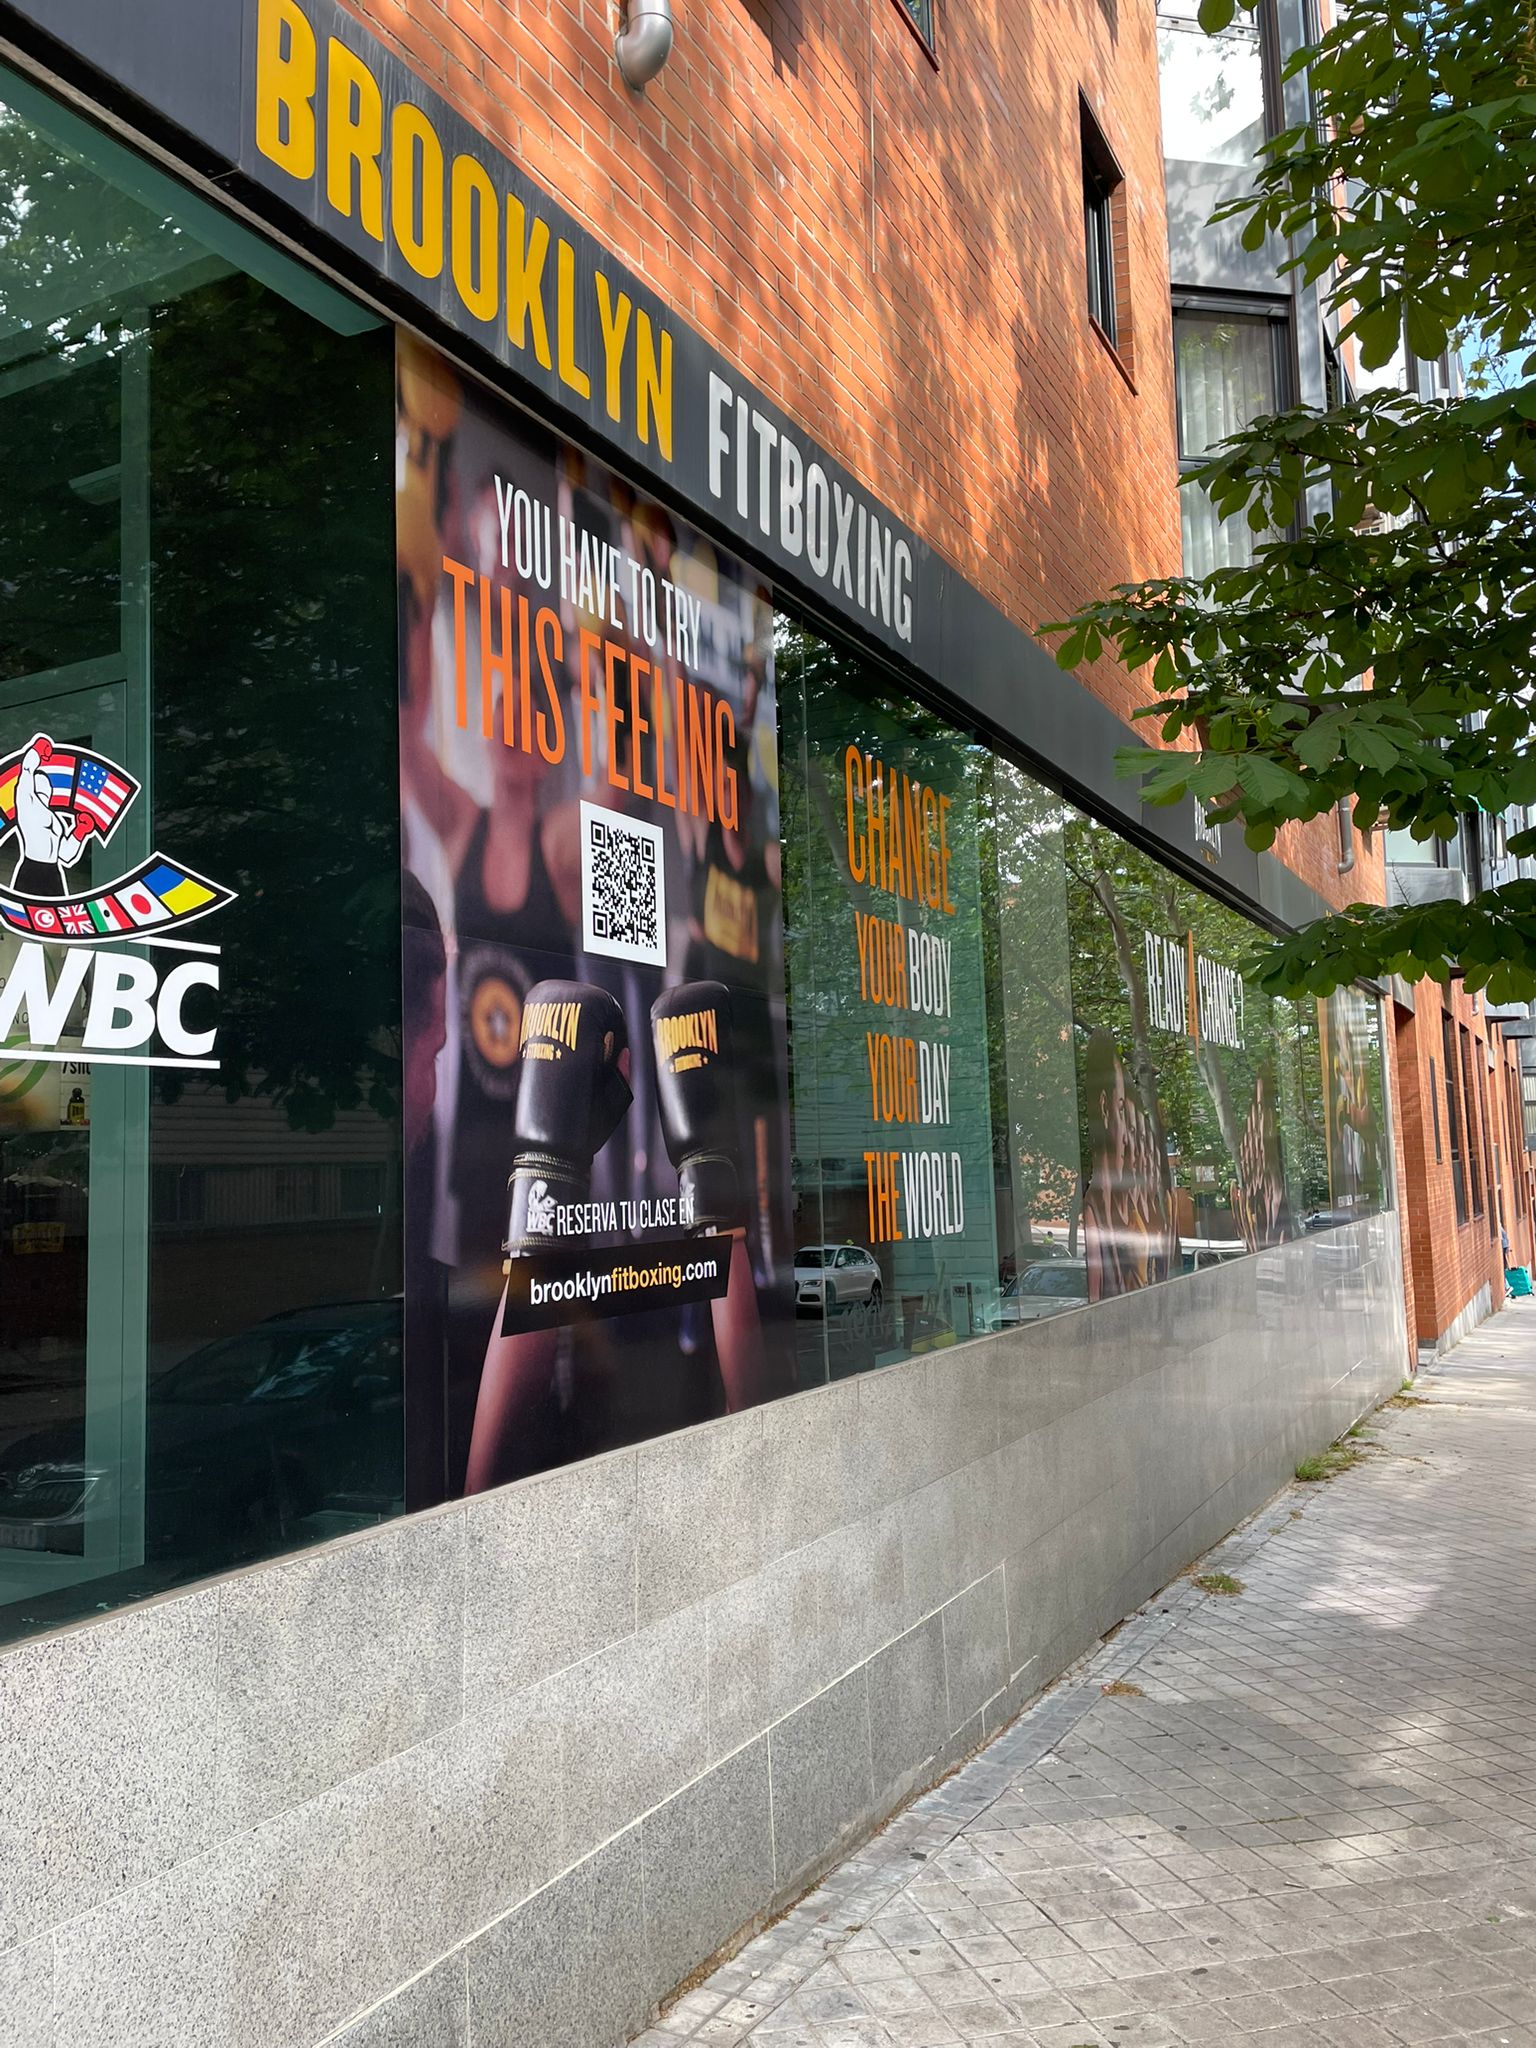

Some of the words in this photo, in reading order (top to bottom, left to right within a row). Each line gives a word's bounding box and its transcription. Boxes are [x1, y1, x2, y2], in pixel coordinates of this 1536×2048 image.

[255, 0, 673, 463] BROOKLYN
[707, 370, 914, 643] FITBOXING
[494, 474, 552, 589] YOU
[559, 515, 624, 631] HAVE
[627, 557, 657, 647] TO
[661, 577, 701, 671] TRY
[442, 555, 566, 765] THIS
[579, 627, 739, 832] FEELING
[845, 744, 956, 916] CHANGE
[855, 911, 908, 1009] YOUR
[908, 928, 951, 1018] BODY
[1145, 930, 1187, 1035] READY
[519, 1002, 581, 1052] BROOKLYN
[656, 1008, 718, 1060] BROOKLYN
[866, 1032, 919, 1124] YOUR
[918, 1040, 950, 1124] DAY
[556, 1200, 617, 1236] RESERVA
[620, 1201, 637, 1230] TU
[640, 1198, 676, 1228] CLASE
[679, 1197, 694, 1225] EN
[863, 1151, 903, 1243] THE
[901, 1151, 964, 1239] WORLD
[530, 1259, 717, 1305] brooklynfitboxing.com
